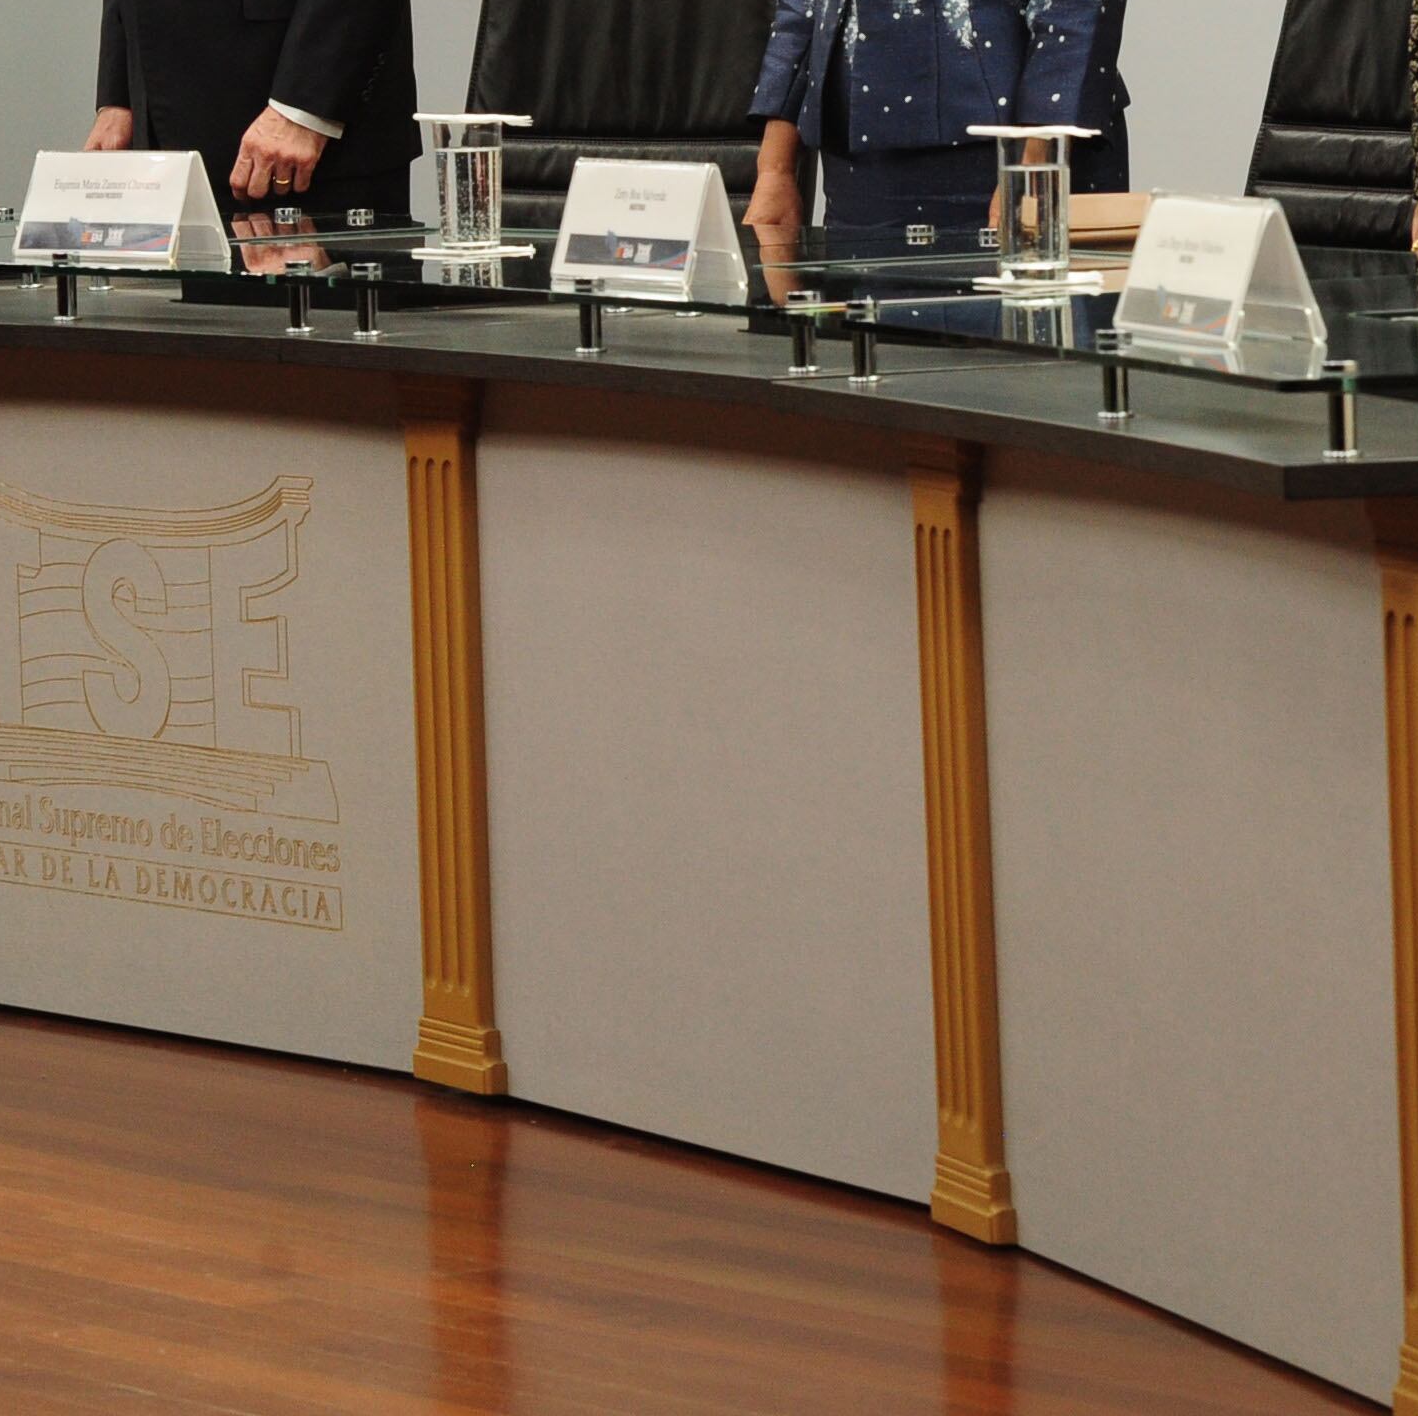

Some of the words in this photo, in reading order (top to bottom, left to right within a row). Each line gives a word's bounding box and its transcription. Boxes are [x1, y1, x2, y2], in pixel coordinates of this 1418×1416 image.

[39, 795, 154, 848] Supremo
[160, 812, 194, 853] de
[199, 815, 342, 873] Elecciones
[41, 852, 75, 885] DE
[87, 858, 122, 892] LA
[135, 864, 332, 922] DEMOCRACIA
